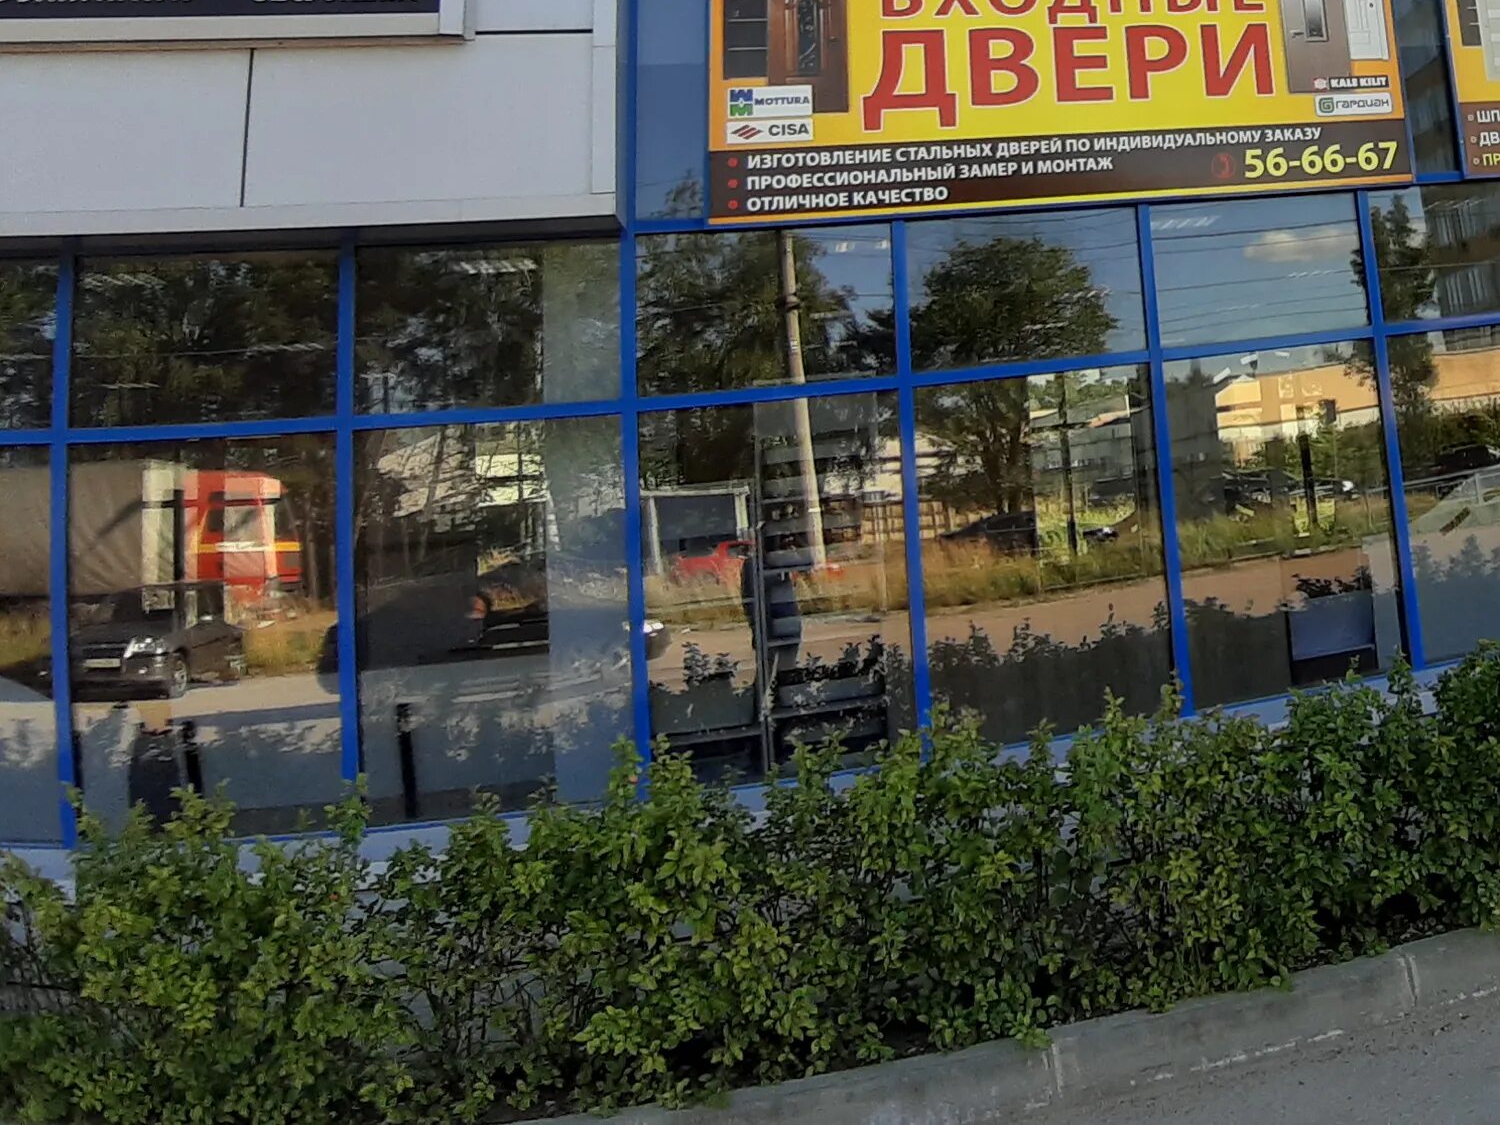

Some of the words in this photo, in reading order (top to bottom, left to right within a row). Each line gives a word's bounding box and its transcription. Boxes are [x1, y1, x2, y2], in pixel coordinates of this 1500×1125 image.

[862, 23, 1275, 133] ДВЕРИ
[1330, 78, 1358, 88] KALE
[1360, 77, 1387, 87] KILIT
[754, 96, 810, 106] MOTTURA
[768, 123, 809, 136] CISA
[747, 148, 892, 169] ИЗГОТОВЛЕНИЕ
[896, 142, 992, 162] СТАЛЬНЫХ
[996, 137, 1062, 158] ДВЕРЕЙ
[1065, 139, 1090, 151] ПО
[1093, 129, 1262, 152] ИНДИВИДУАЛЬНОМУ
[1265, 127, 1322, 143] ЗАКАЗУ
[1244, 141, 1398, 178] 56-66-67
[747, 165, 955, 191] ПРОФЕССИОНАЛЬНЫЙ
[959, 161, 1018, 179] ЗАМЕР
[1021, 161, 1033, 175] И
[1037, 156, 1113, 174] МОНТАЖ
[746, 192, 849, 211] ОТЛИЧНОЕ
[853, 186, 949, 206] КАЧЕСТВО
